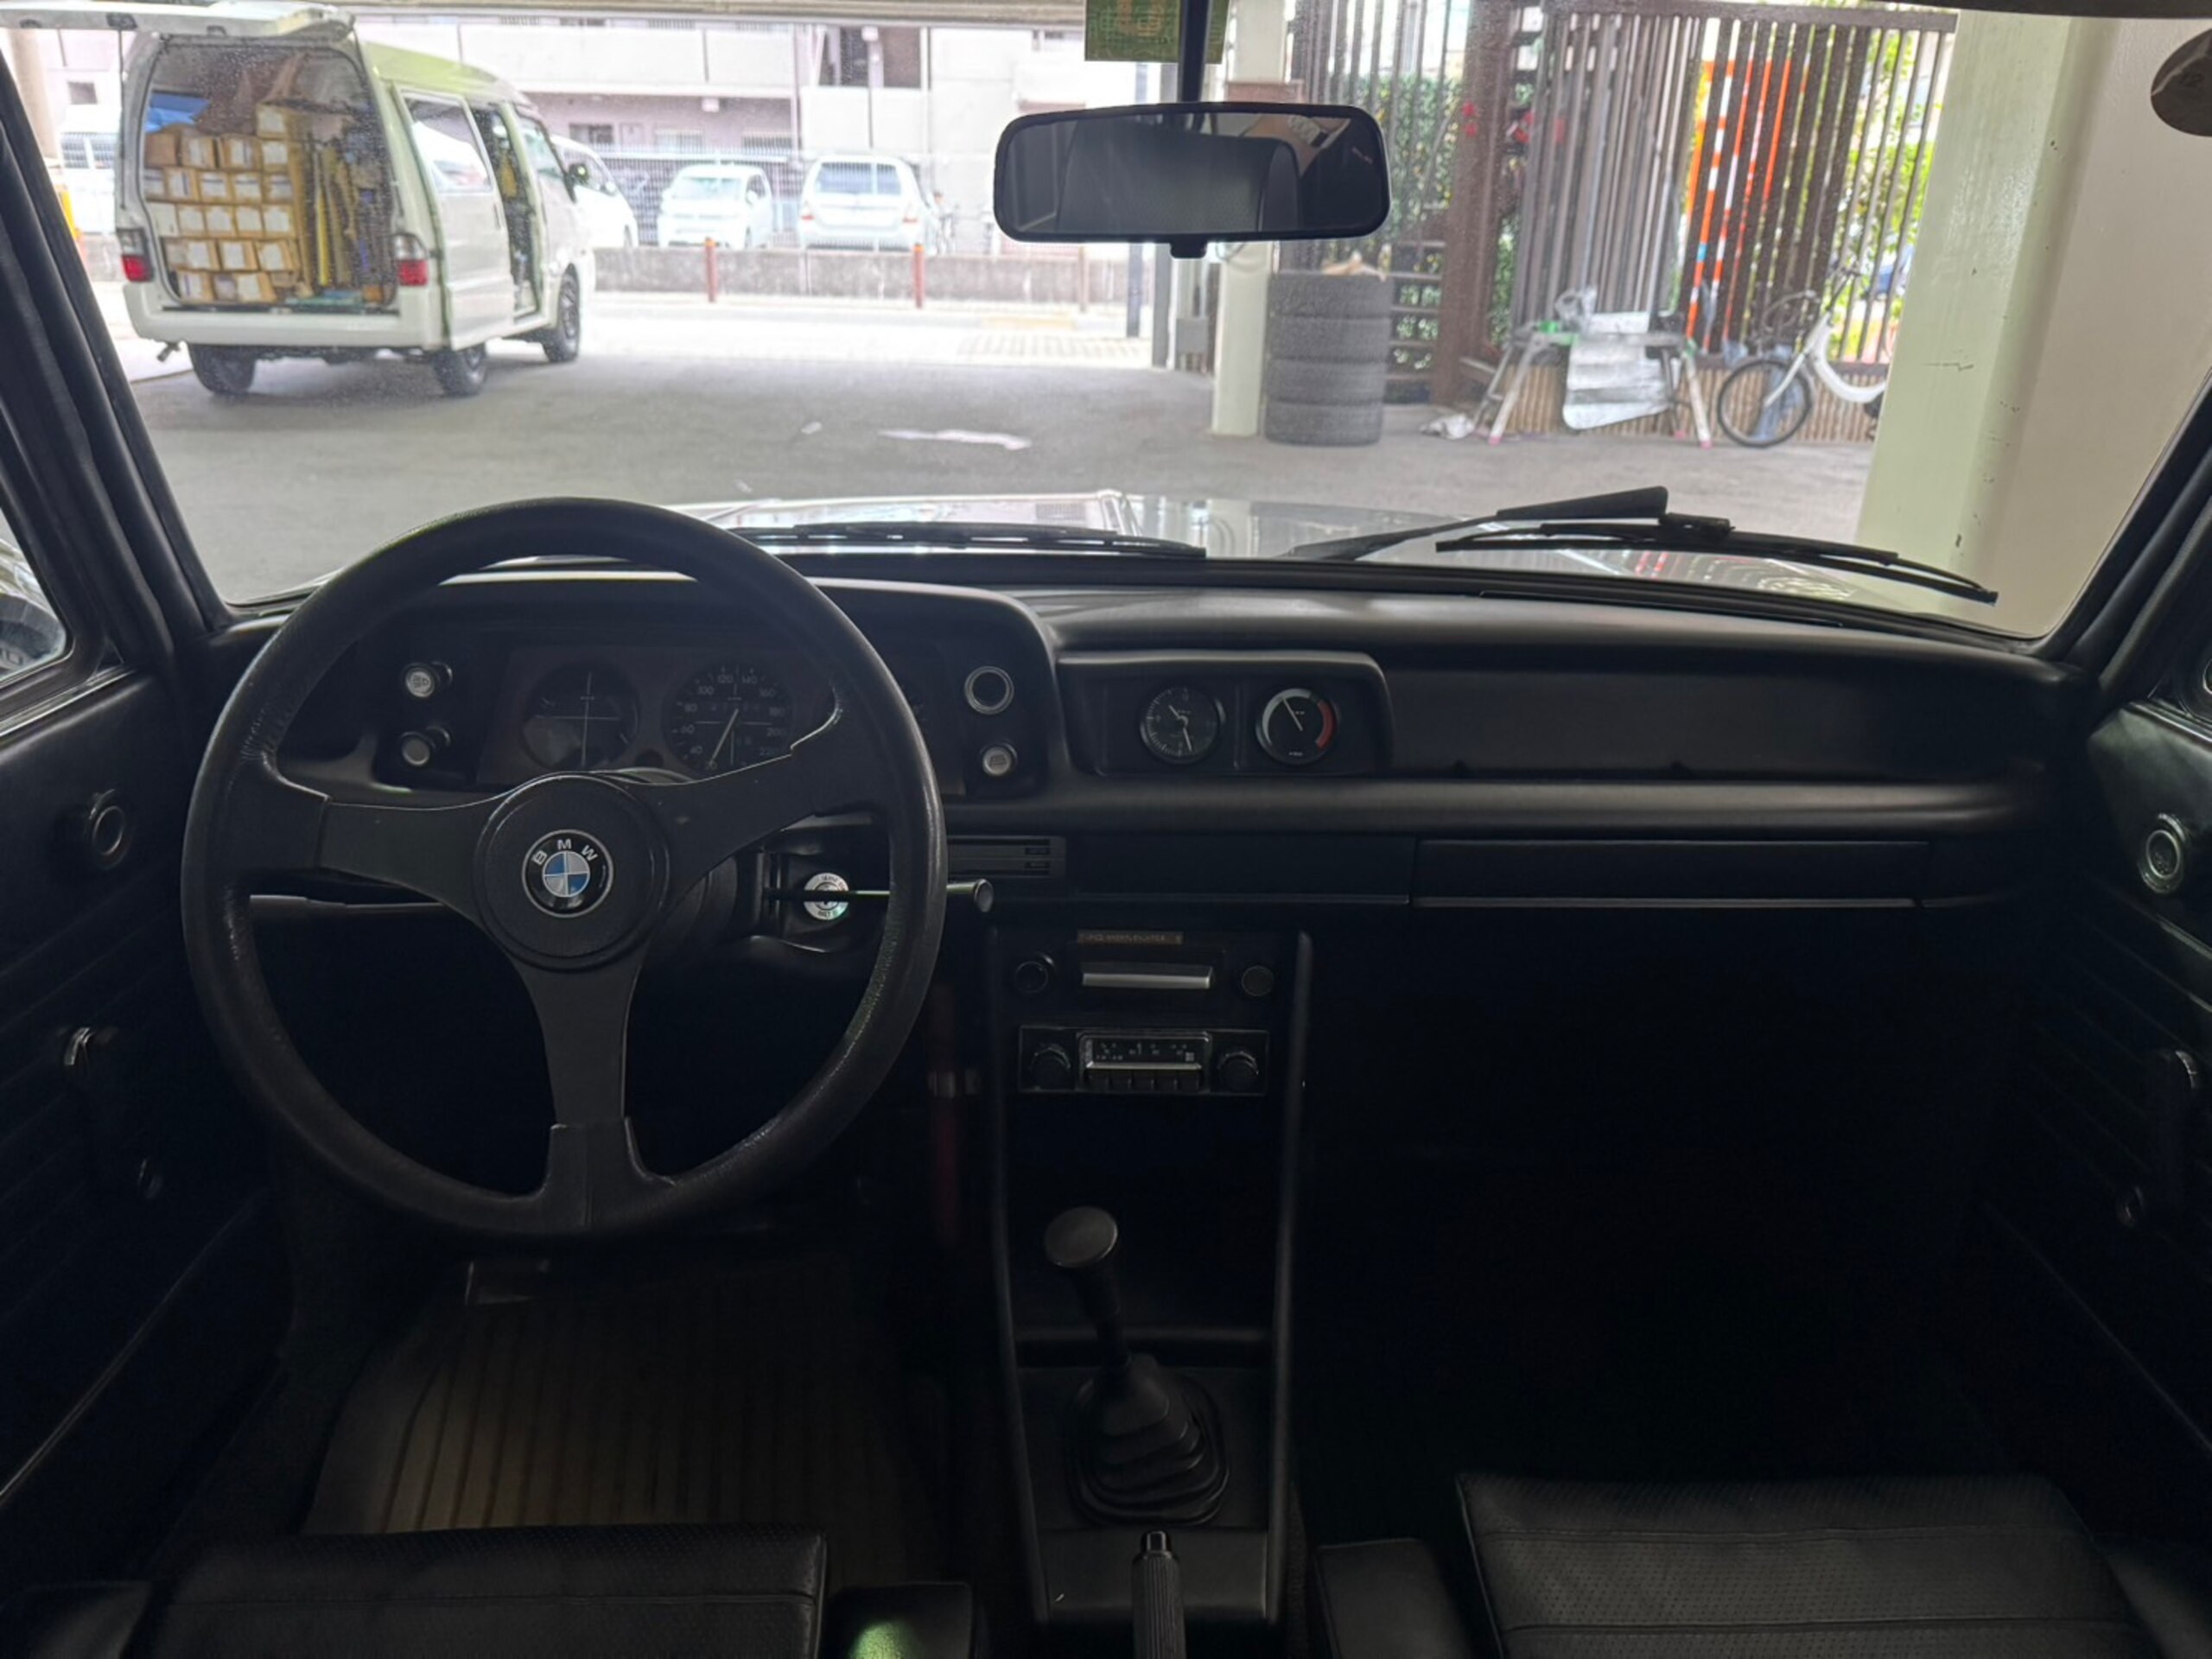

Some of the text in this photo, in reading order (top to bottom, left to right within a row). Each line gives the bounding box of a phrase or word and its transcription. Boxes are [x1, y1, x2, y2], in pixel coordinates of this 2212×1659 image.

[717, 674, 733, 683] 120
[742, 675, 758, 684] 140
[698, 685, 715, 696] 100
[759, 687, 776, 697] 160
[684, 703, 698, 713] 80
[680, 724, 695, 734] 60
[766, 728, 786, 737] 200
[689, 745, 703, 755] 40
[531, 838, 599, 865] BMW
